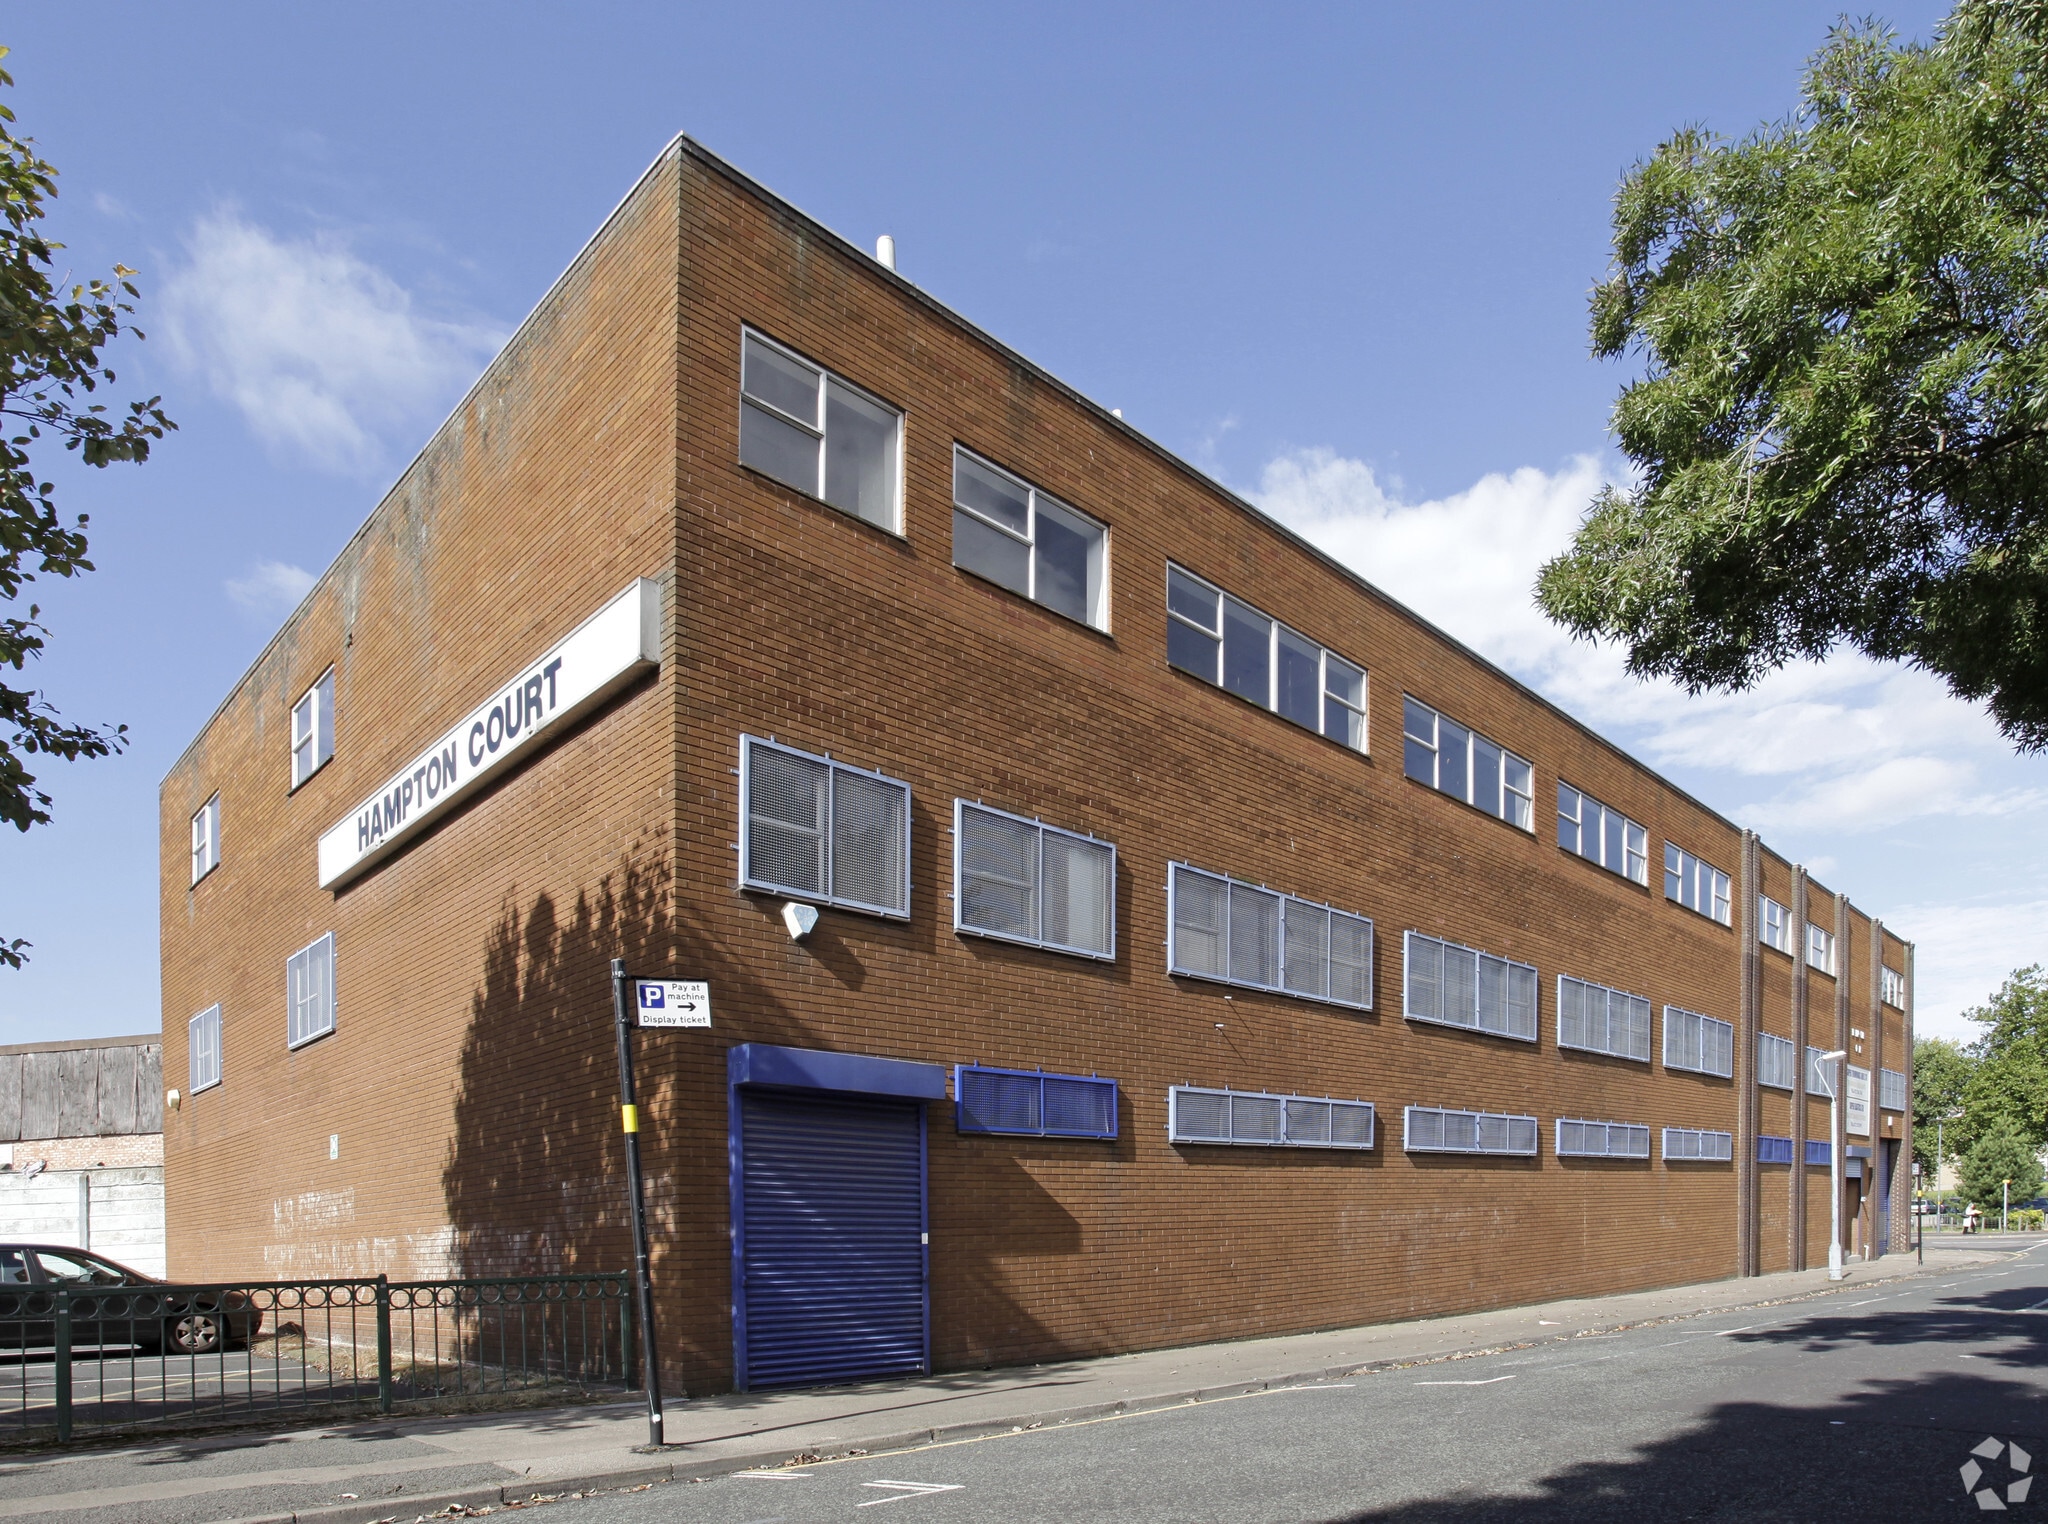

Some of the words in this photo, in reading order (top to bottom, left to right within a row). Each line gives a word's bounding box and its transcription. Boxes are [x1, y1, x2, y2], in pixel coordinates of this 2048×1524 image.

[358, 740, 457, 852] HAMPTON
[468, 656, 562, 767] COURT
[672, 983, 688, 992] Pay
[645, 987, 661, 1006] P
[643, 1015, 677, 1024] Display
